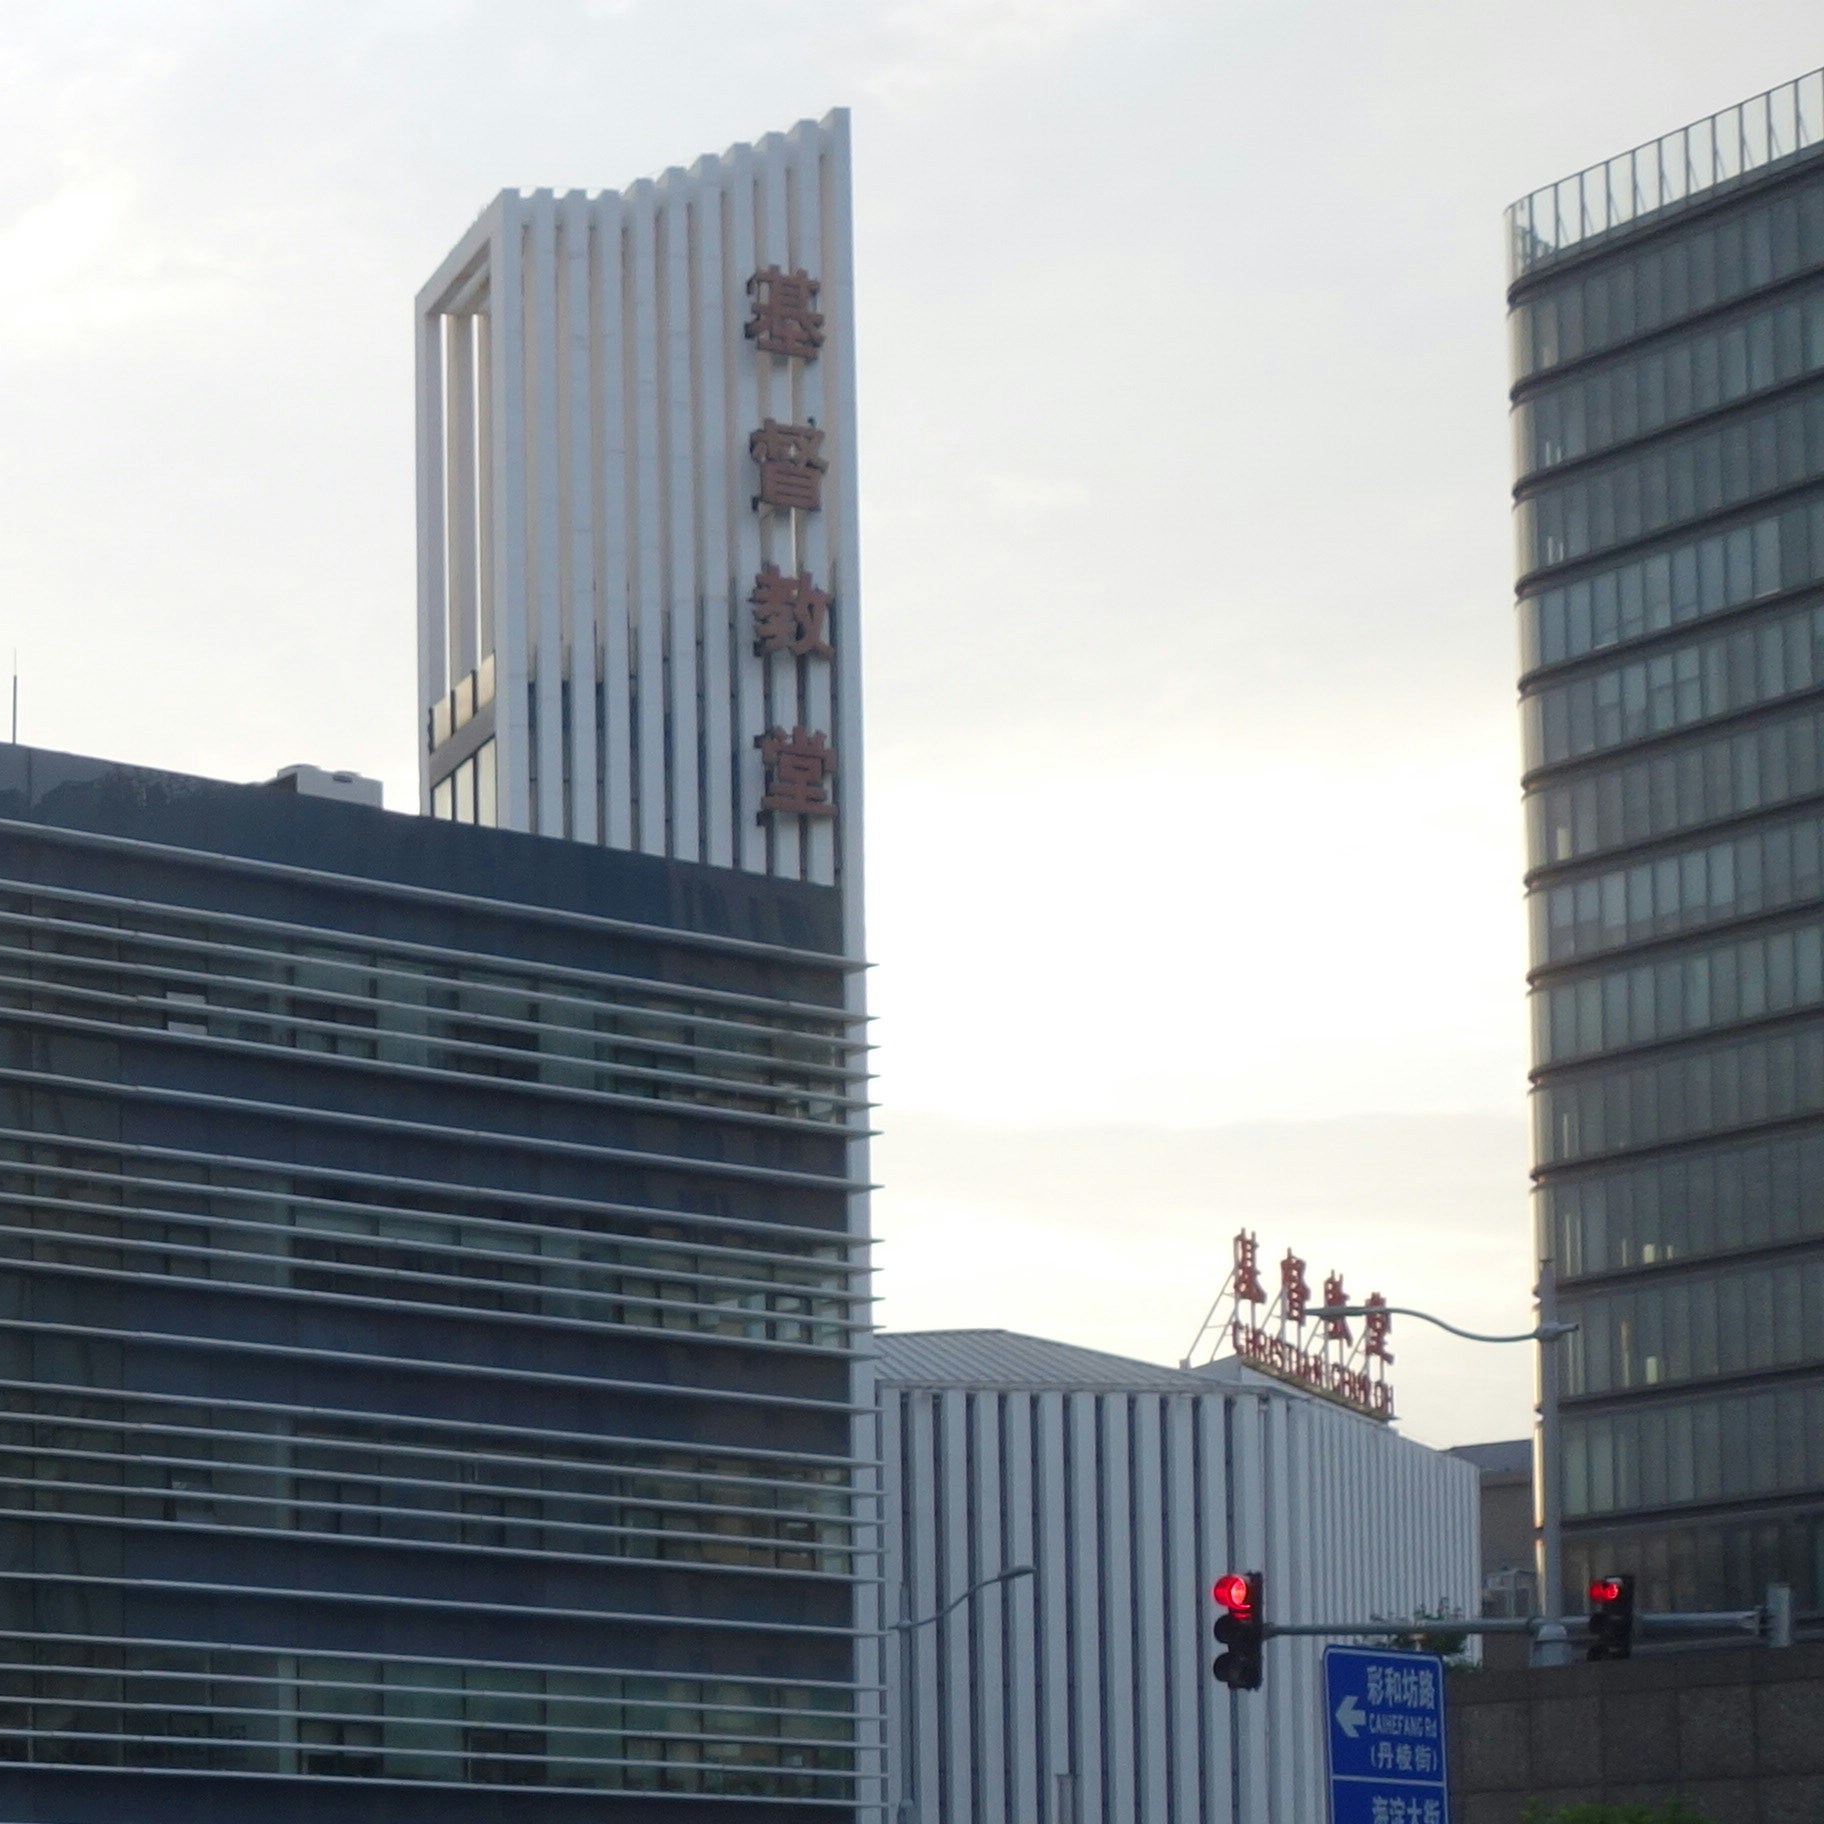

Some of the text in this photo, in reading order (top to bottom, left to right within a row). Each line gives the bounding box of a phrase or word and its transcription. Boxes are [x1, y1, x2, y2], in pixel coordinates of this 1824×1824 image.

[745, 264, 839, 826] 基督教堂
[1233, 1226, 1394, 1365] 基督教堂
[1367, 1665, 1435, 1709] 彩和坊路
[1369, 1713, 1422, 1736] CAIHEFANG
